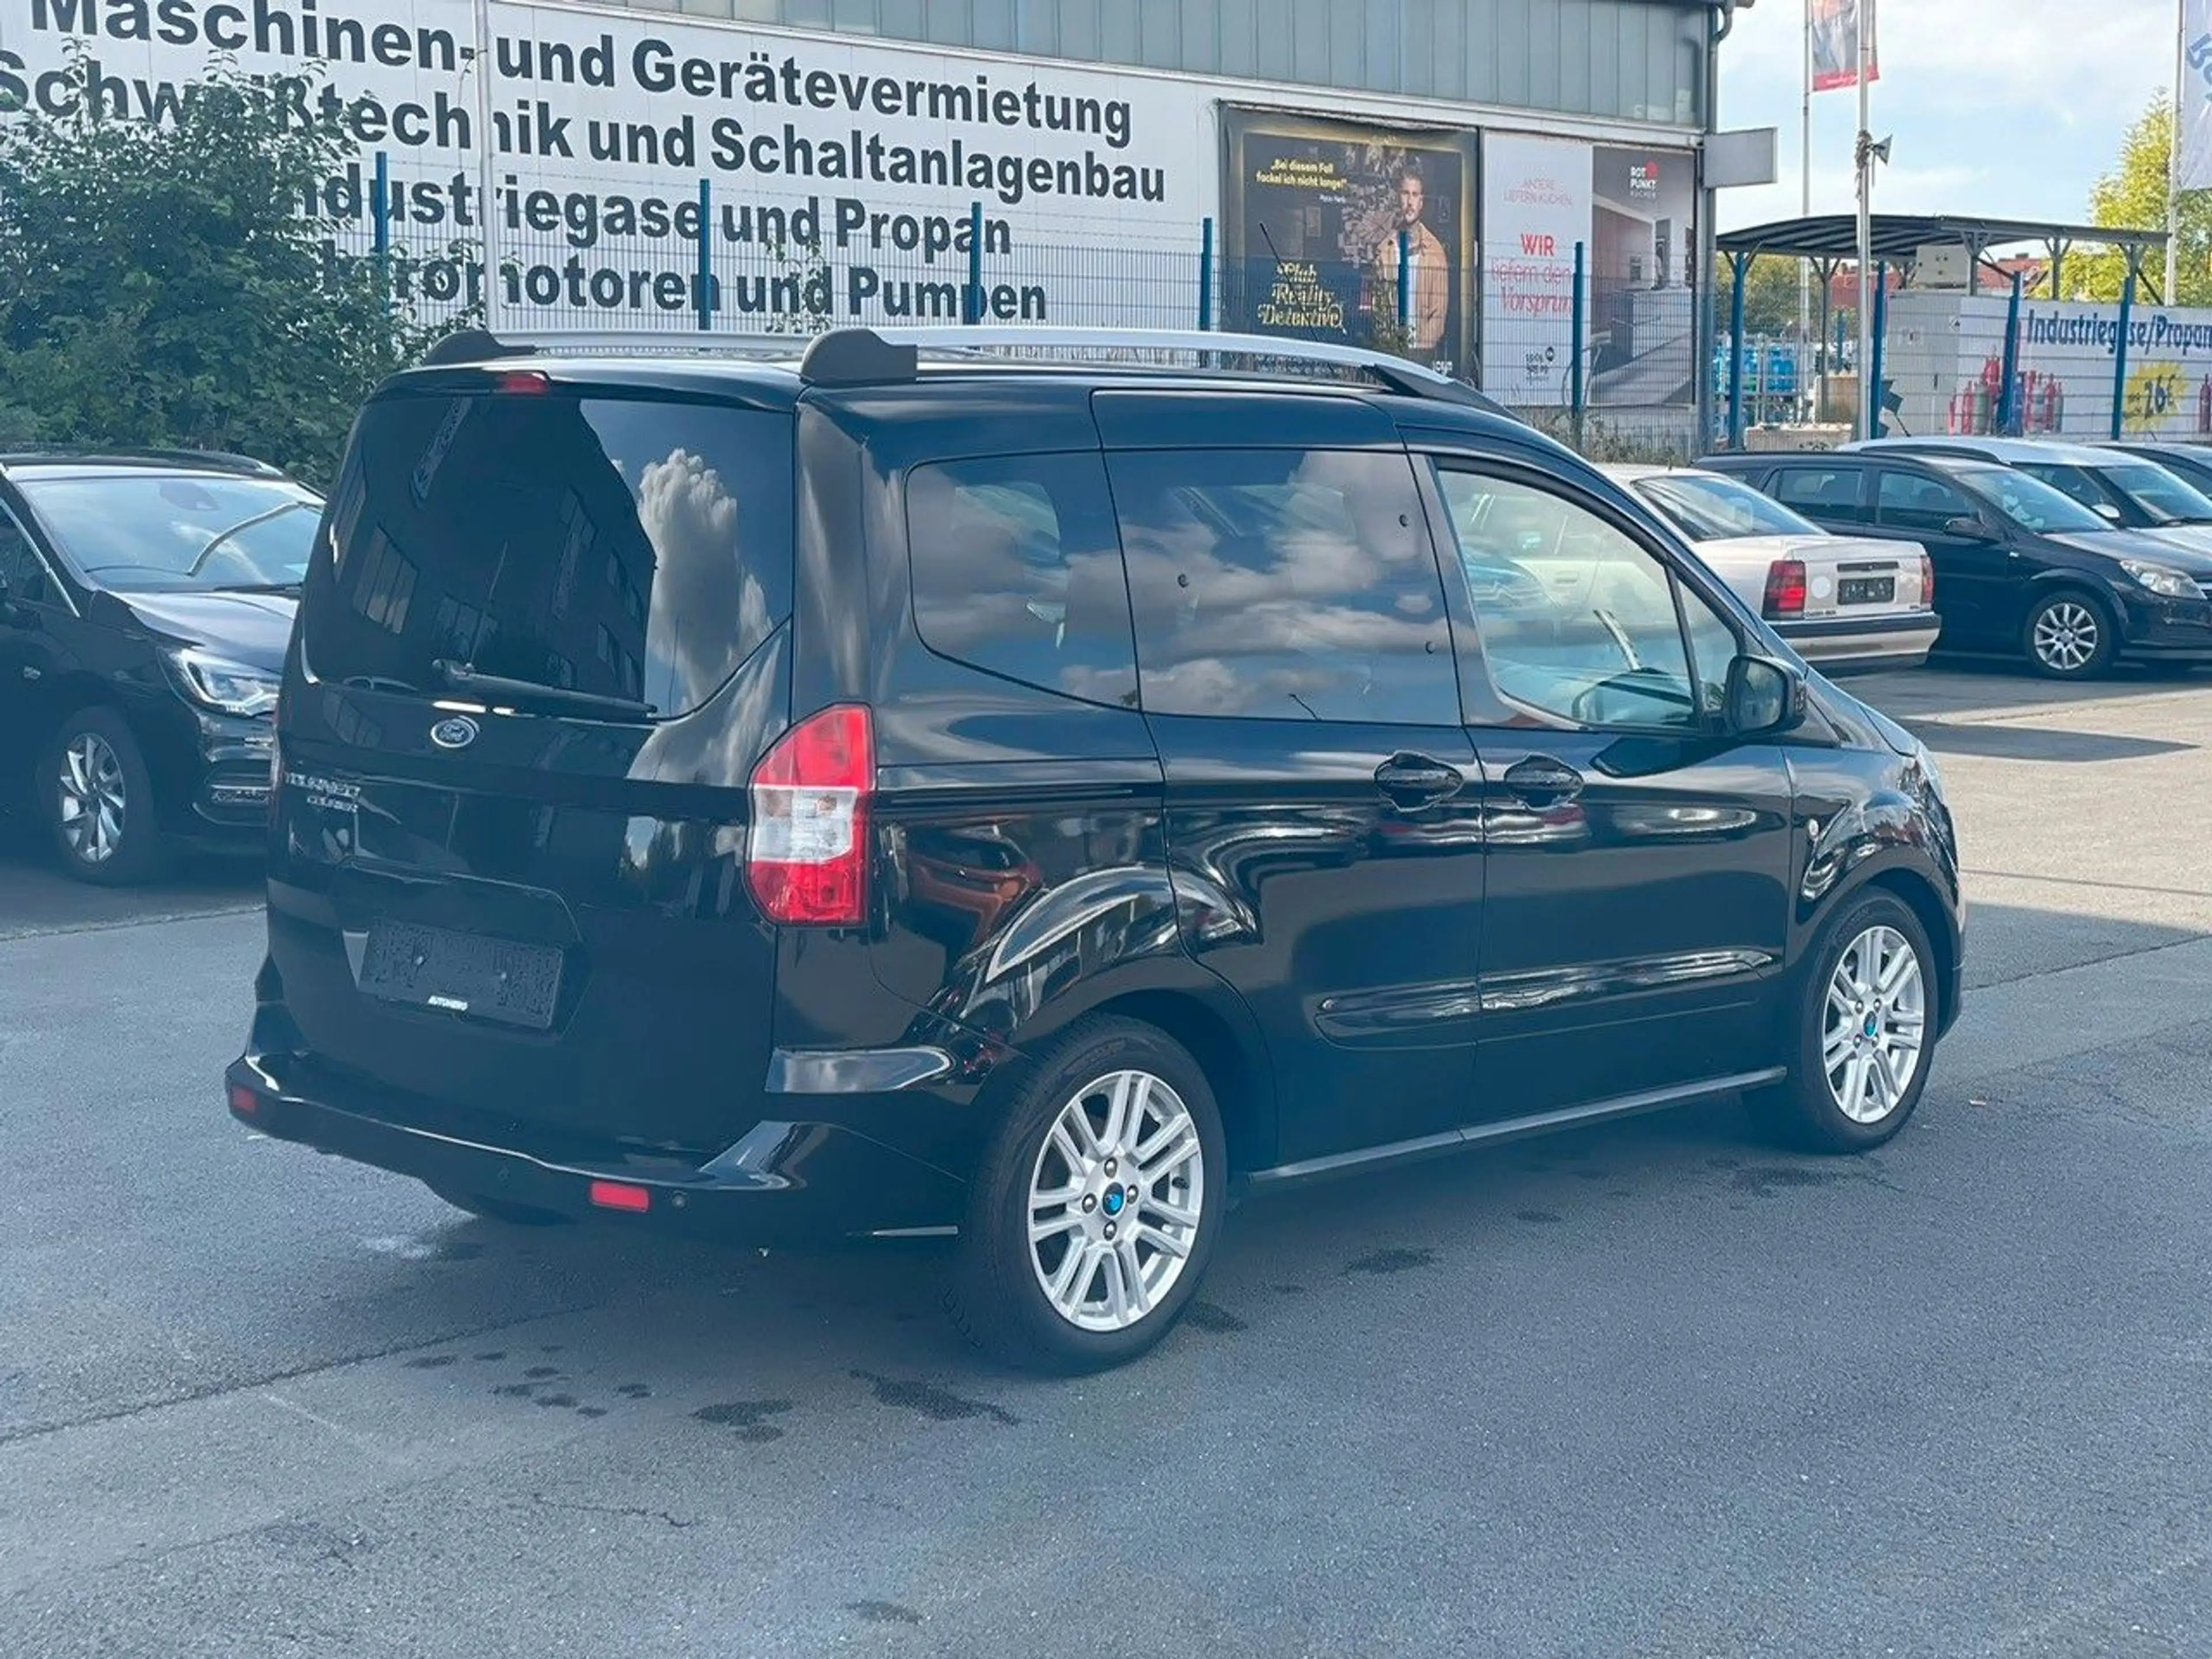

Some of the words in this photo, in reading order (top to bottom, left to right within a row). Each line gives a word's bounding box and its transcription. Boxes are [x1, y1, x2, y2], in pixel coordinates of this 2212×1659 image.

[31, 0, 475, 71] Maschinen-
[497, 35, 615, 88] und
[632, 39, 1131, 149] Gerätevermietung
[0, 50, 575, 158] Schwßtechnik
[589, 115, 696, 167] und
[710, 118, 1165, 204] Schaltanlagenbau
[722, 196, 820, 246] und
[836, 197, 1011, 264] Propan
[1520, 233, 1555, 257] WIR
[736, 266, 834, 315] und
[1501, 288, 1573, 317] Vorsprun
[2027, 309, 2212, 355] Industriegse/Propan
